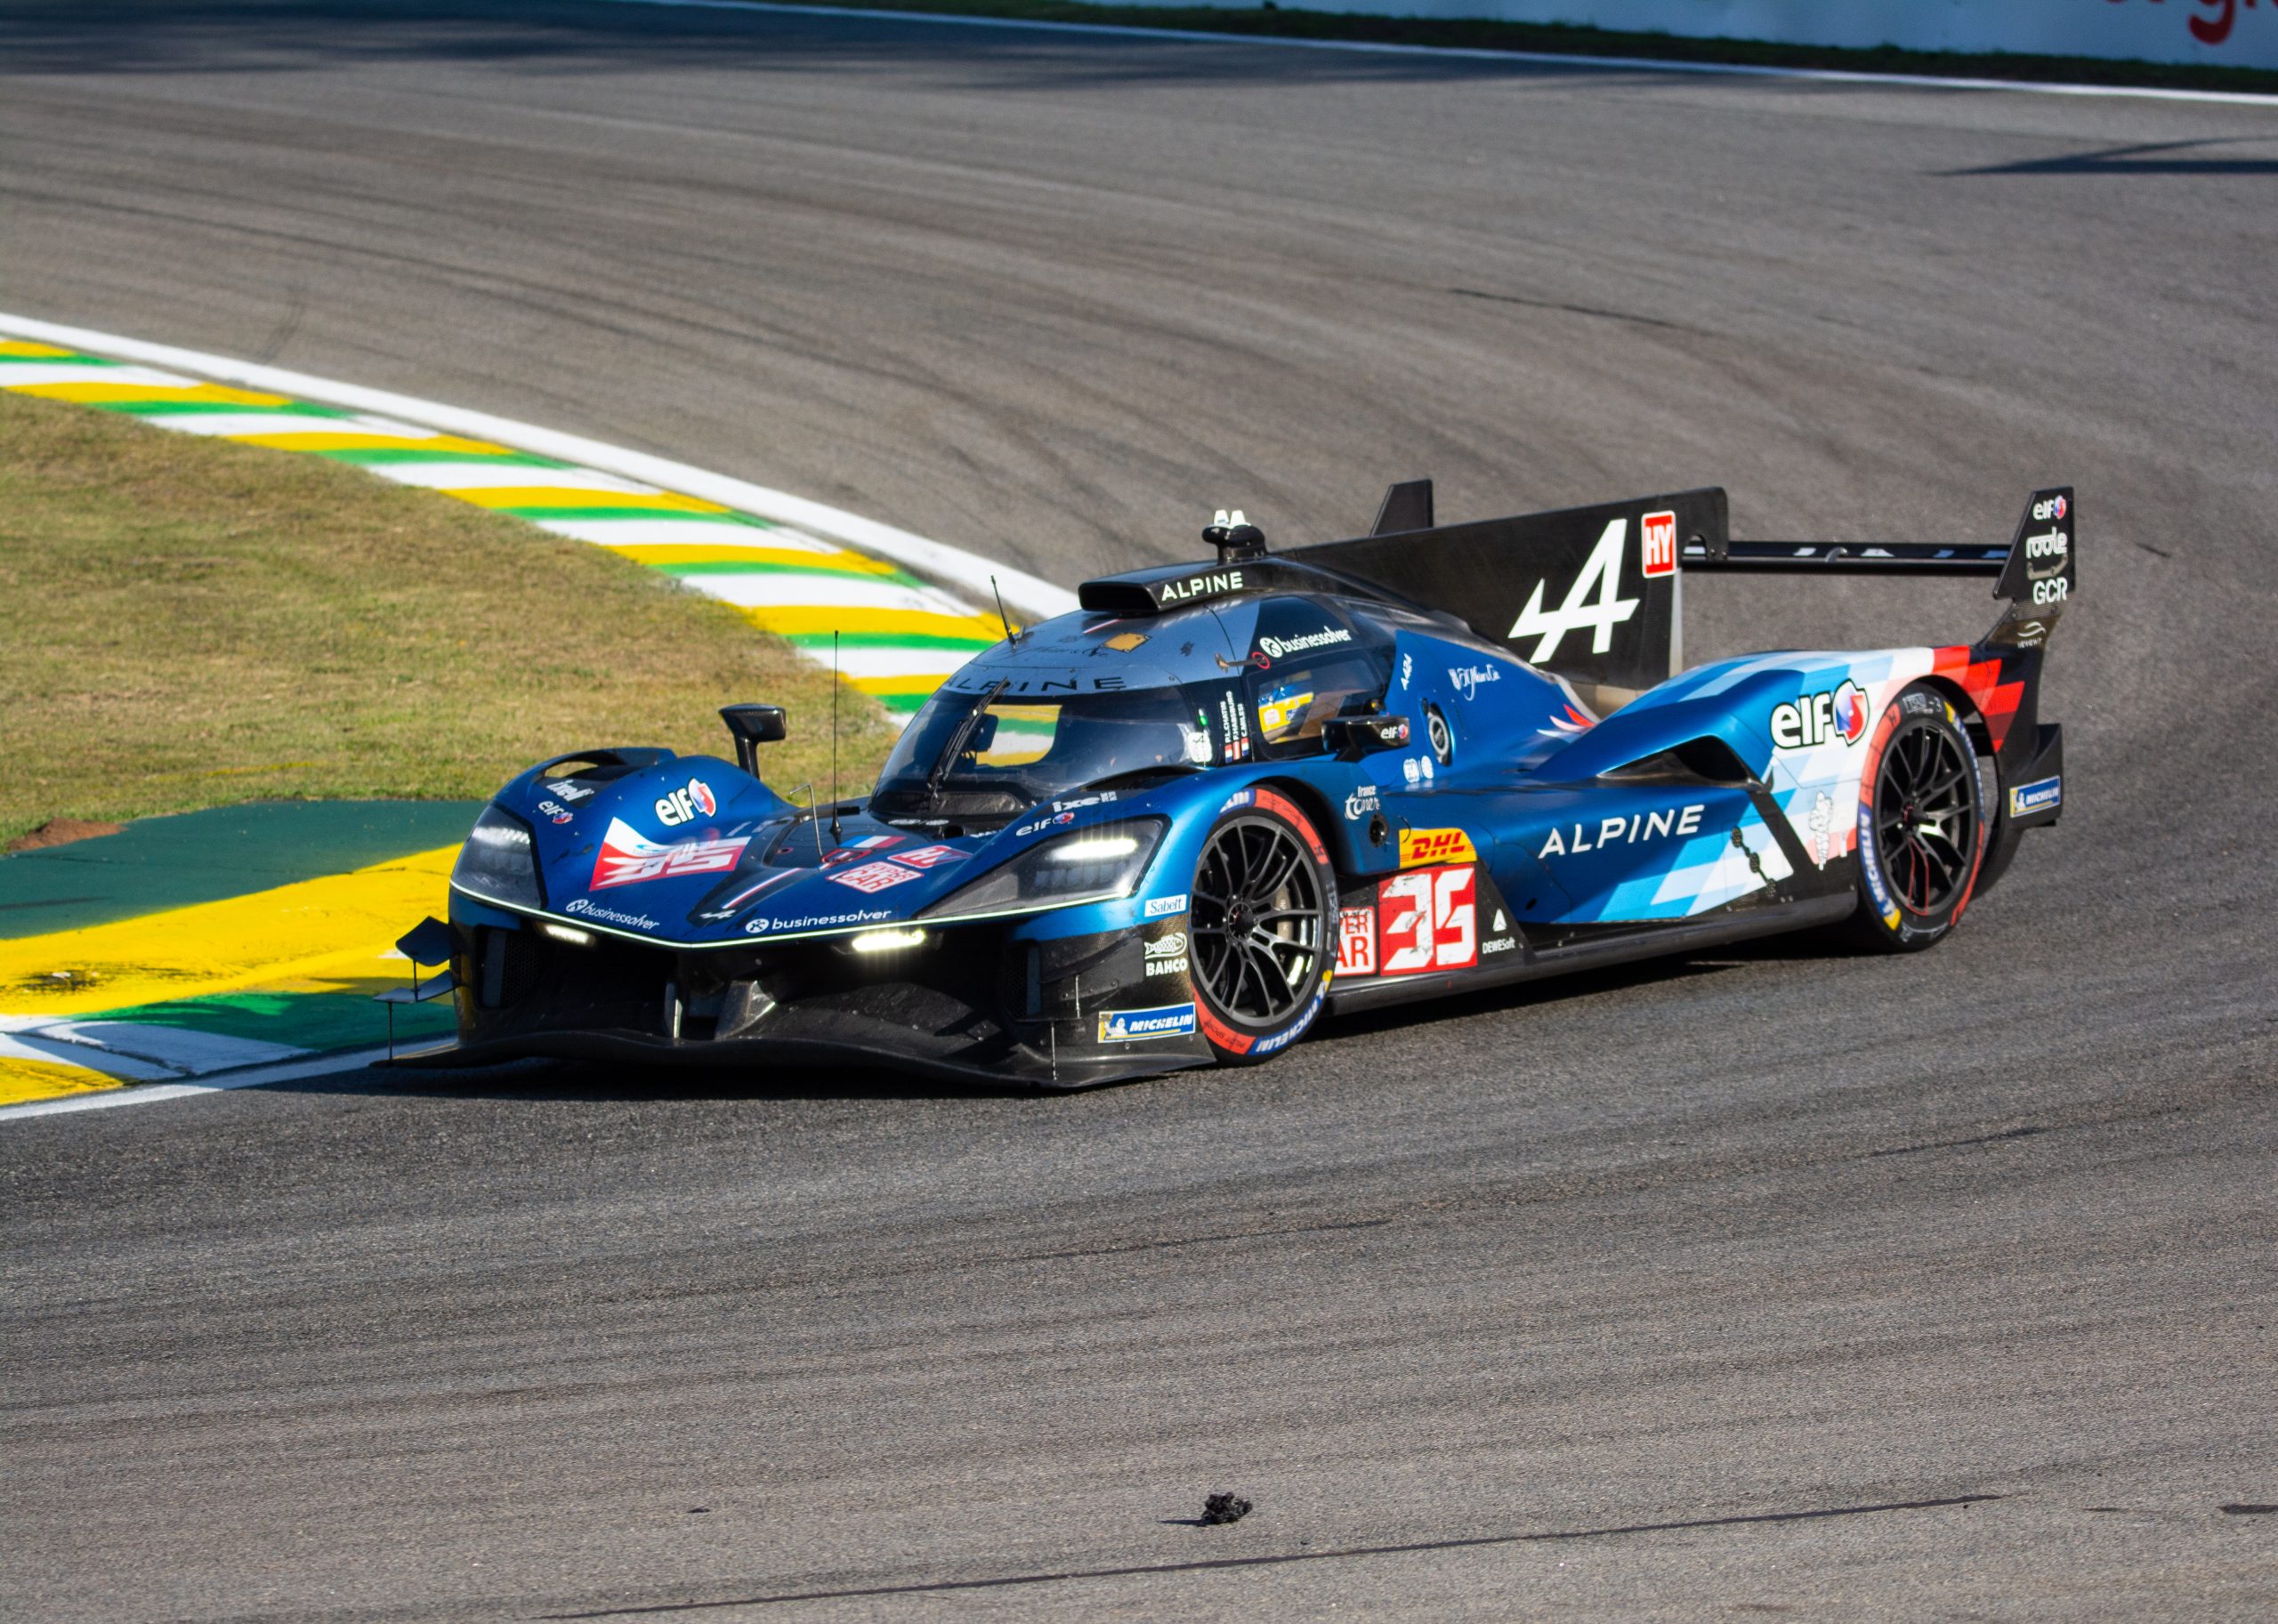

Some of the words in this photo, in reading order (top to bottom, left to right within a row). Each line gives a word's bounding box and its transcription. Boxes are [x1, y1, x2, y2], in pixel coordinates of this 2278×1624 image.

[2033, 500, 2054, 520] elf
[1645, 523, 1673, 566] HY
[1161, 571, 1243, 601] ALPINE
[2033, 577, 2067, 605] GCR
[1278, 626, 1352, 653] businessolver
[948, 676, 1127, 691] ALPINE
[1380, 727, 1397, 739] elf
[1770, 691, 1832, 749] elf
[538, 801, 564, 818] elf
[655, 788, 695, 826] elf
[1015, 818, 1051, 836] elf
[1538, 804, 1705, 860] ALPINE
[1411, 832, 1466, 860] DHL
[581, 902, 660, 931] businessolver
[772, 909, 892, 930] businessolver
[1150, 898, 1183, 914] Sabelt
[1382, 868, 1476, 971] 35
[1145, 957, 1188, 977] BAHCO
[1129, 1014, 1194, 1032] MICHELIN
[1256, 999, 1318, 1053] MICHELIN
